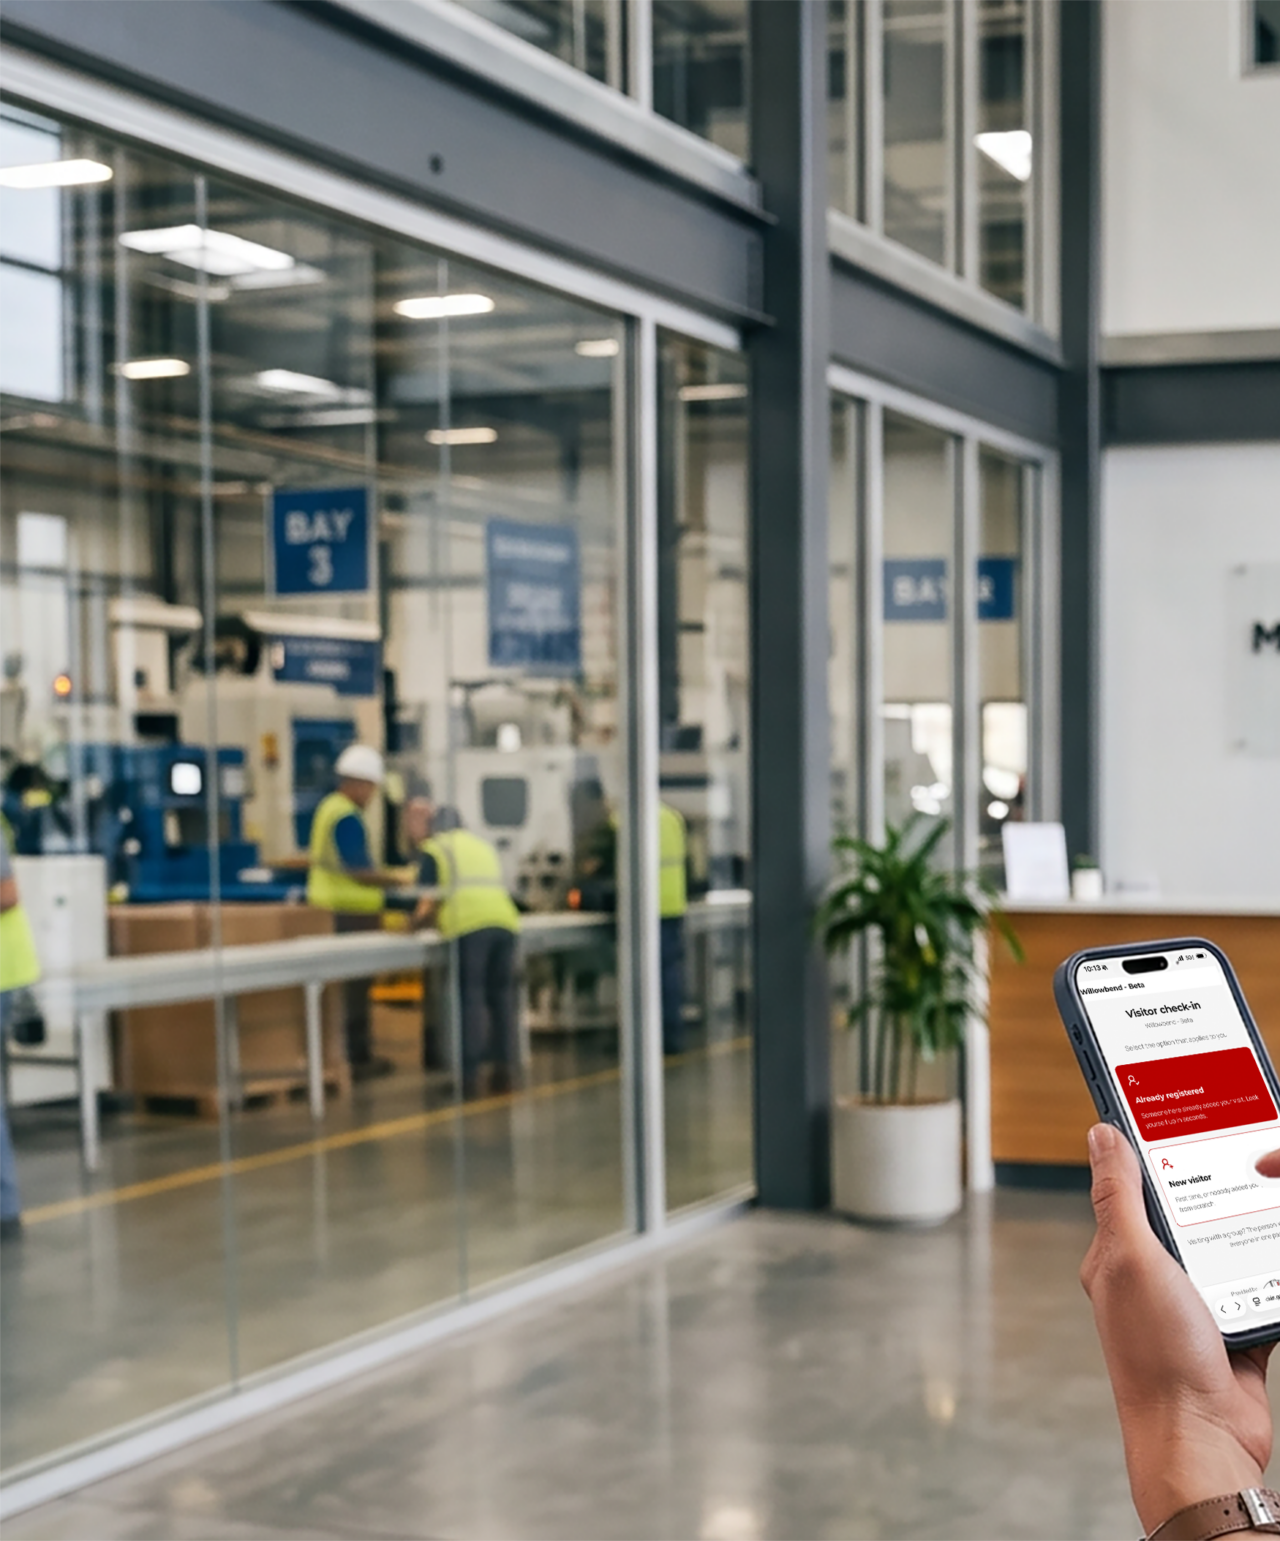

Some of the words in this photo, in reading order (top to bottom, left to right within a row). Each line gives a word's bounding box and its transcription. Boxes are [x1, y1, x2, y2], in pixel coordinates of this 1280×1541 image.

[285, 508, 353, 545] BAY
[308, 546, 333, 586] 3
[1083, 964, 1102, 972] 10:13
[1080, 984, 1123, 996] Willowbend
[1128, 982, 1145, 990] Beta
[1125, 1008, 1158, 1018] Visitor
[1160, 1001, 1201, 1014] check-in
[1124, 1043, 1144, 1052] Select
[1156, 1040, 1175, 1048] option
[1188, 1034, 1209, 1043] applies
[1136, 1094, 1164, 1104] Already
[1166, 1086, 1204, 1099] registered
[1168, 1180, 1187, 1188] New
[1188, 1174, 1212, 1184] visitor
[1230, 1184, 1249, 1192] added
[1258, 1222, 1277, 1232] person
[1230, 1237, 1254, 1248] everyone
